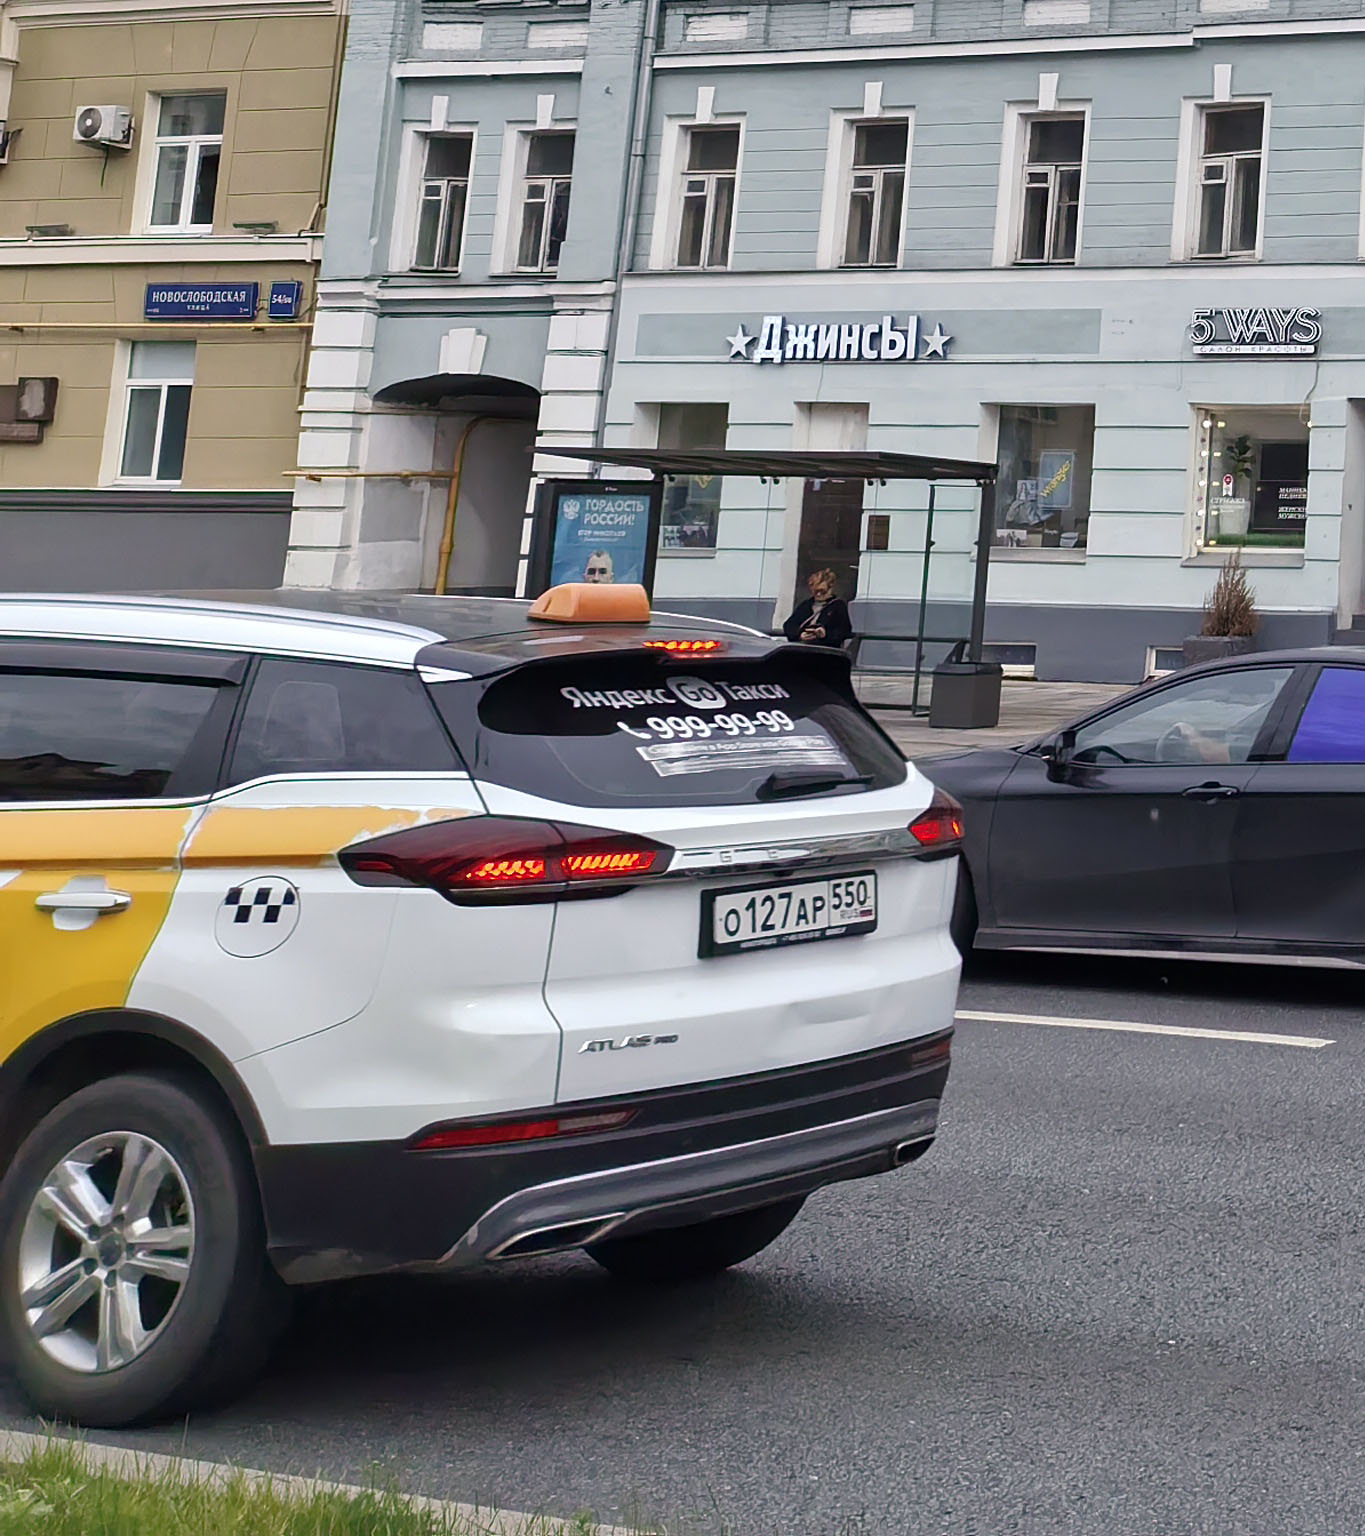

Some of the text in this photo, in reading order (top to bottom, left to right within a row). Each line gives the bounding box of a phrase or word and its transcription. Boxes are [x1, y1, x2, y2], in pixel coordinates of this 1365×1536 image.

[152, 290, 247, 304] НОВОСЛОБОДСКАЯ
[1189, 307, 1322, 344] 5 WAYS
[1199, 345, 1241, 353] САЛОН
[585, 499, 645, 512] ГОРДОСТЬ
[583, 513, 636, 526] РОССИИ!
[560, 686, 677, 710] Яндекс
[714, 681, 791, 703] Такси
[646, 709, 796, 740] 999-99-99
[724, 879, 868, 937] О127АР 550
[839, 908, 860, 919] RUS
[578, 1033, 653, 1054] ATLAS
